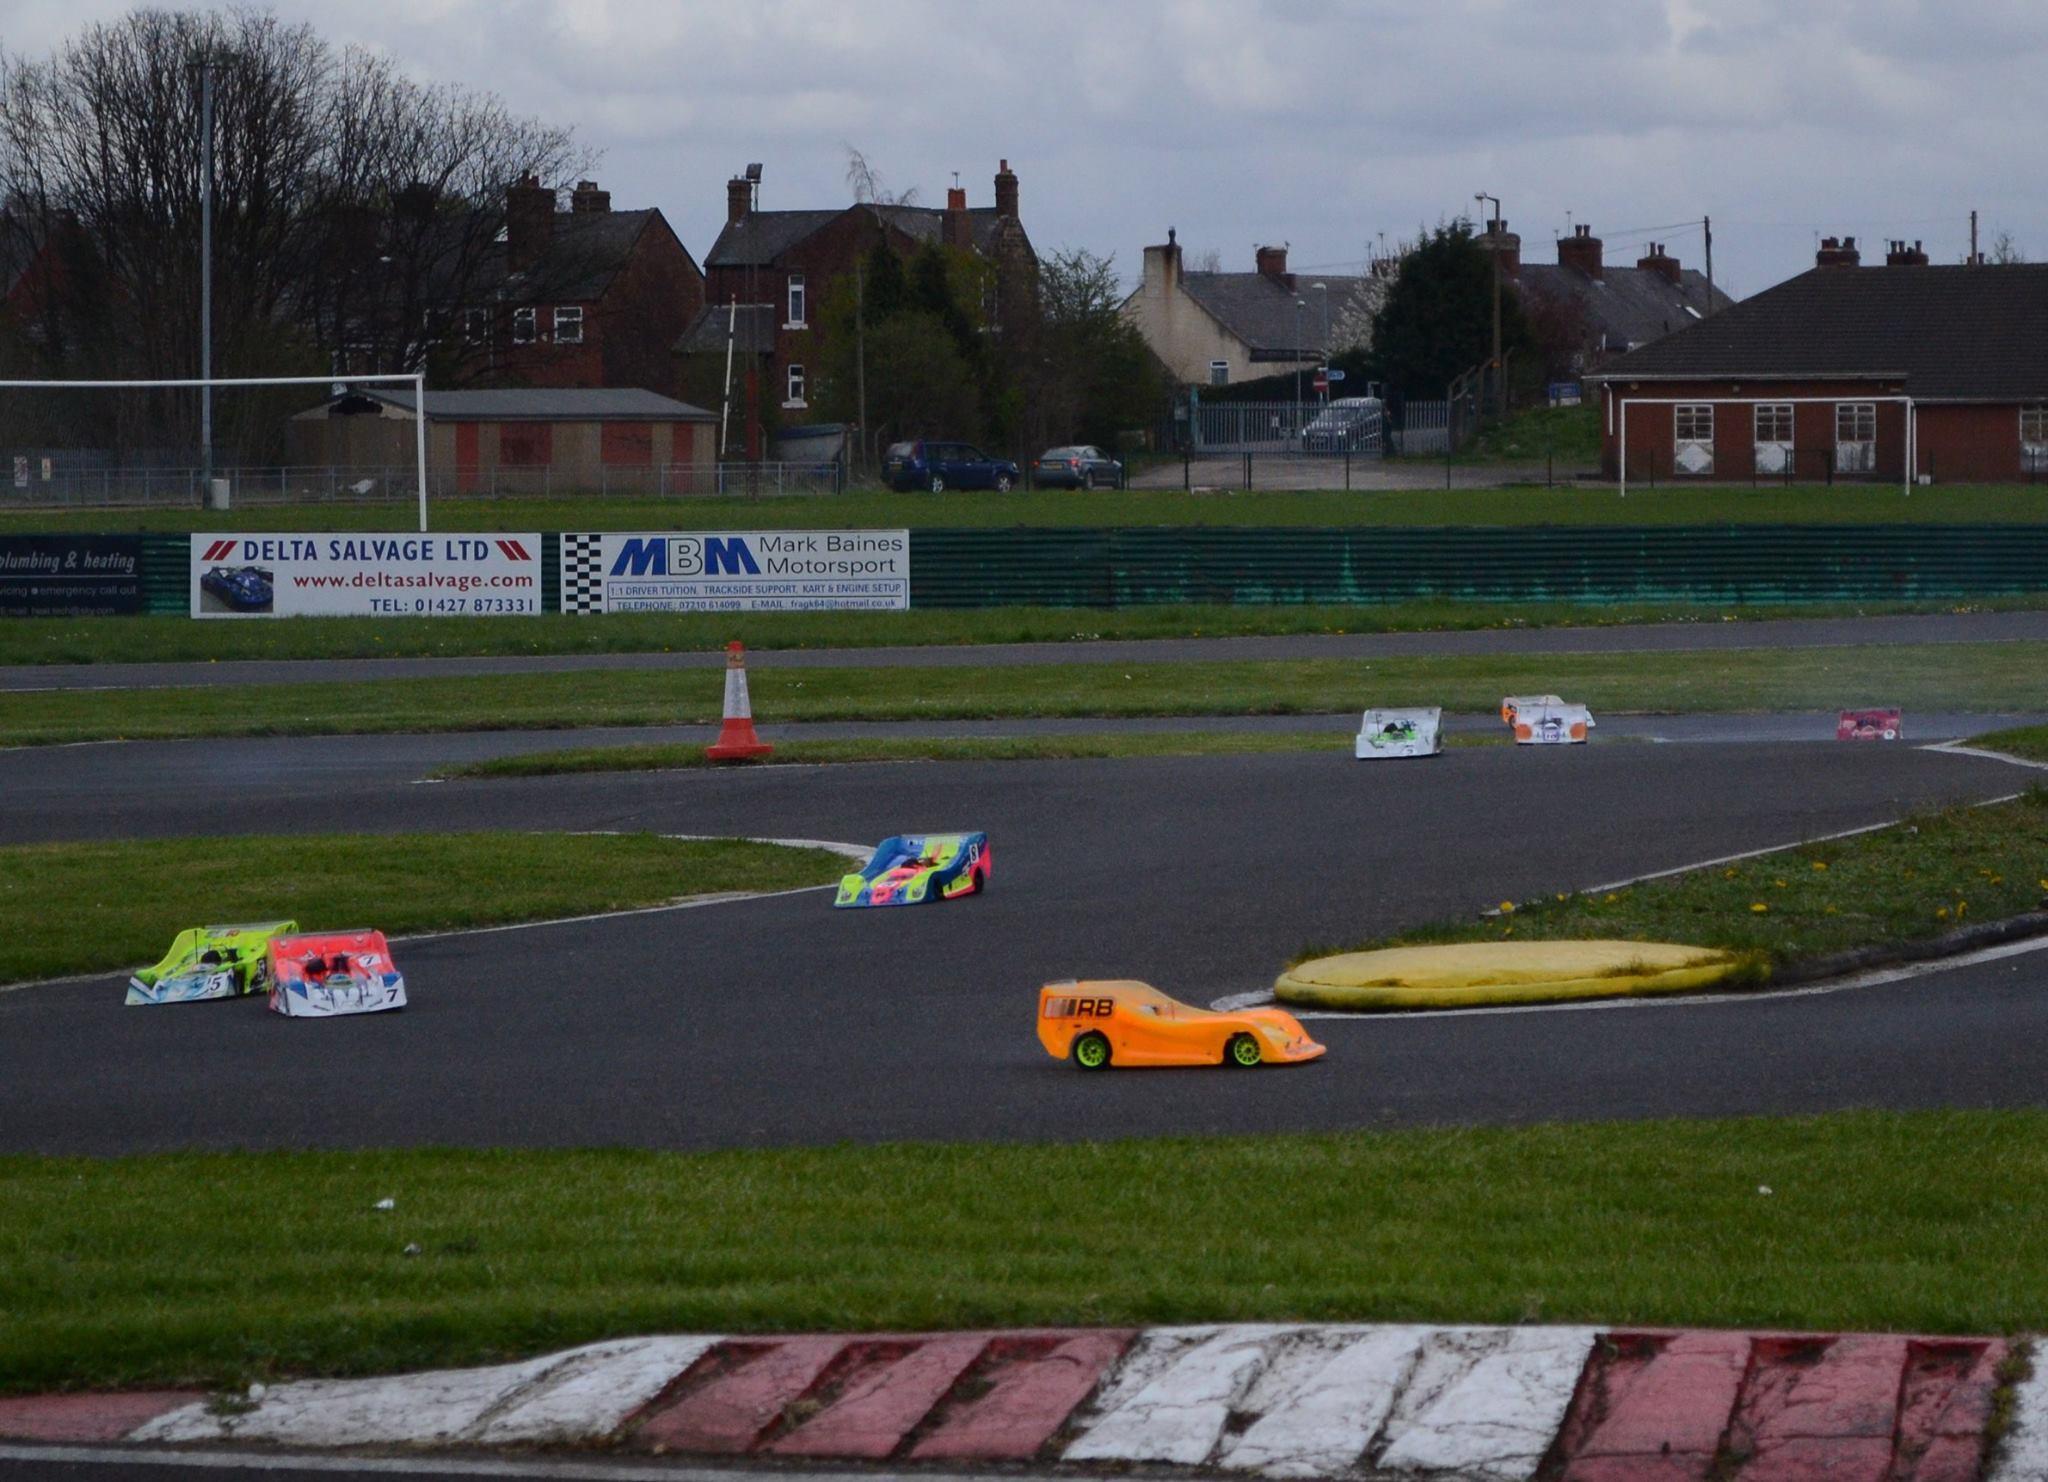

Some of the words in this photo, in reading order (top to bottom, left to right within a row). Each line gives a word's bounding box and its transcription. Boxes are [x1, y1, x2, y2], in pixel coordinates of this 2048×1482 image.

[244, 540, 318, 561] DELTA
[330, 540, 434, 561] SALVAGE
[446, 540, 489, 561] LTD
[760, 536, 818, 552] Mark
[827, 535, 903, 552] Baines
[64, 550, 78, 568] &
[83, 551, 136, 573] heating
[609, 537, 761, 576] MBM
[766, 557, 896, 576] Motorsport
[294, 572, 533, 592] www.deltasalvage.com
[626, 585, 658, 596] DRIVER
[704, 585, 753, 595] TRACKSIDE
[803, 584, 826, 594] KART
[836, 583, 869, 593] ENGINE
[40, 587, 97, 597] emergency
[370, 598, 408, 612] TEL:
[415, 598, 466, 612] 01427
[473, 598, 533, 612] 873331
[386, 988, 398, 1002] 7
[1077, 998, 1114, 1017] RB
